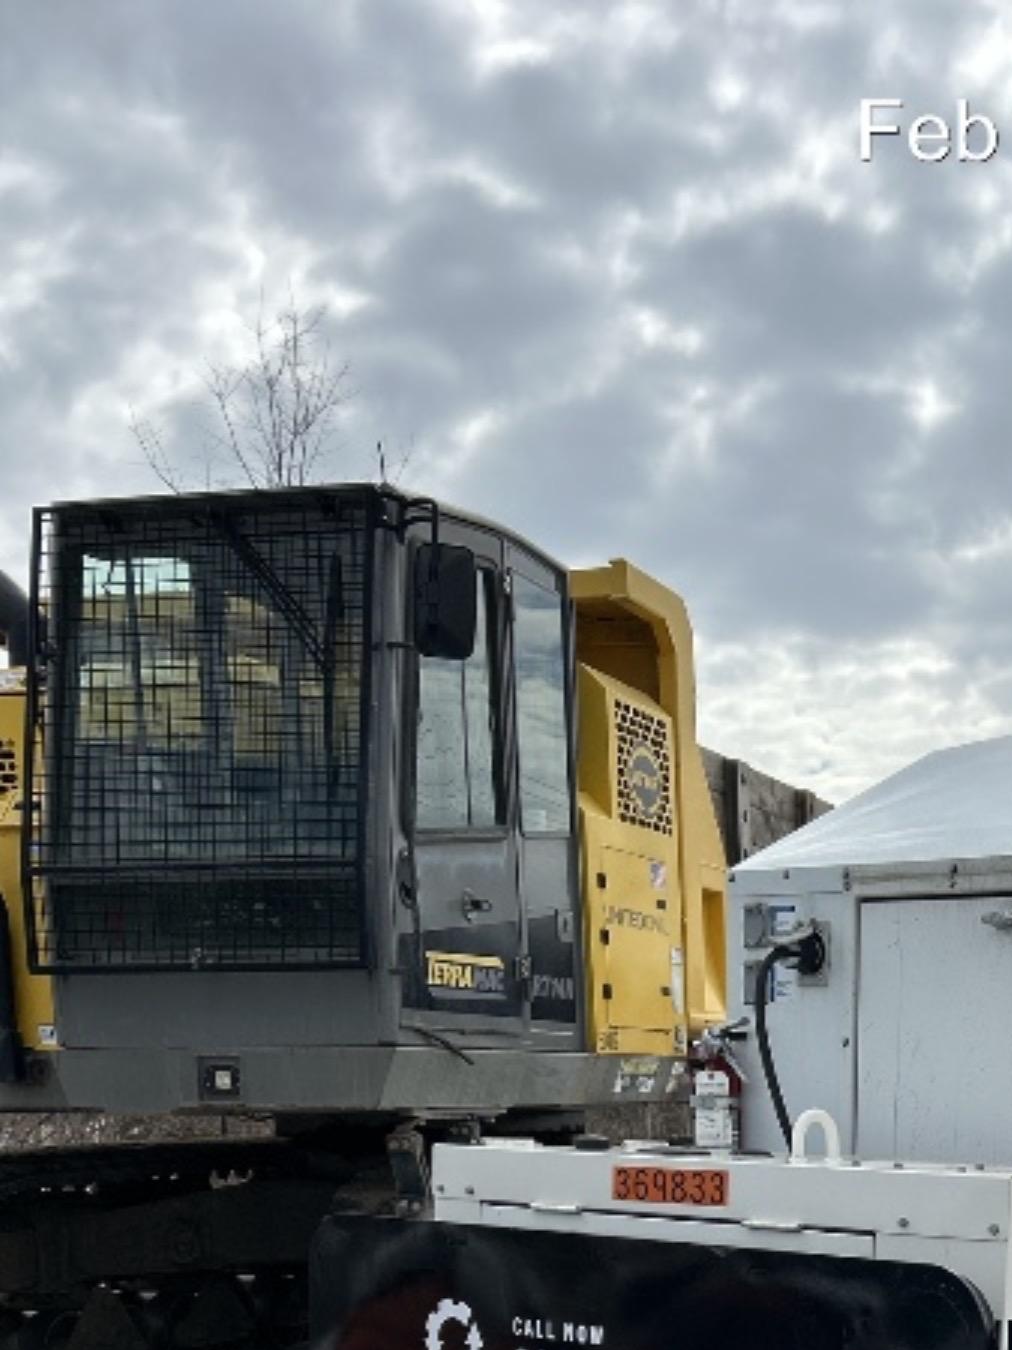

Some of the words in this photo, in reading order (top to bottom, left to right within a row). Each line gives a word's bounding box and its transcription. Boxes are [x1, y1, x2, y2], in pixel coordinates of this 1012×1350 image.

[616, 1168, 725, 1205] 369833
[512, 1316, 556, 1341] CALL
[563, 1321, 605, 1346] NOW
